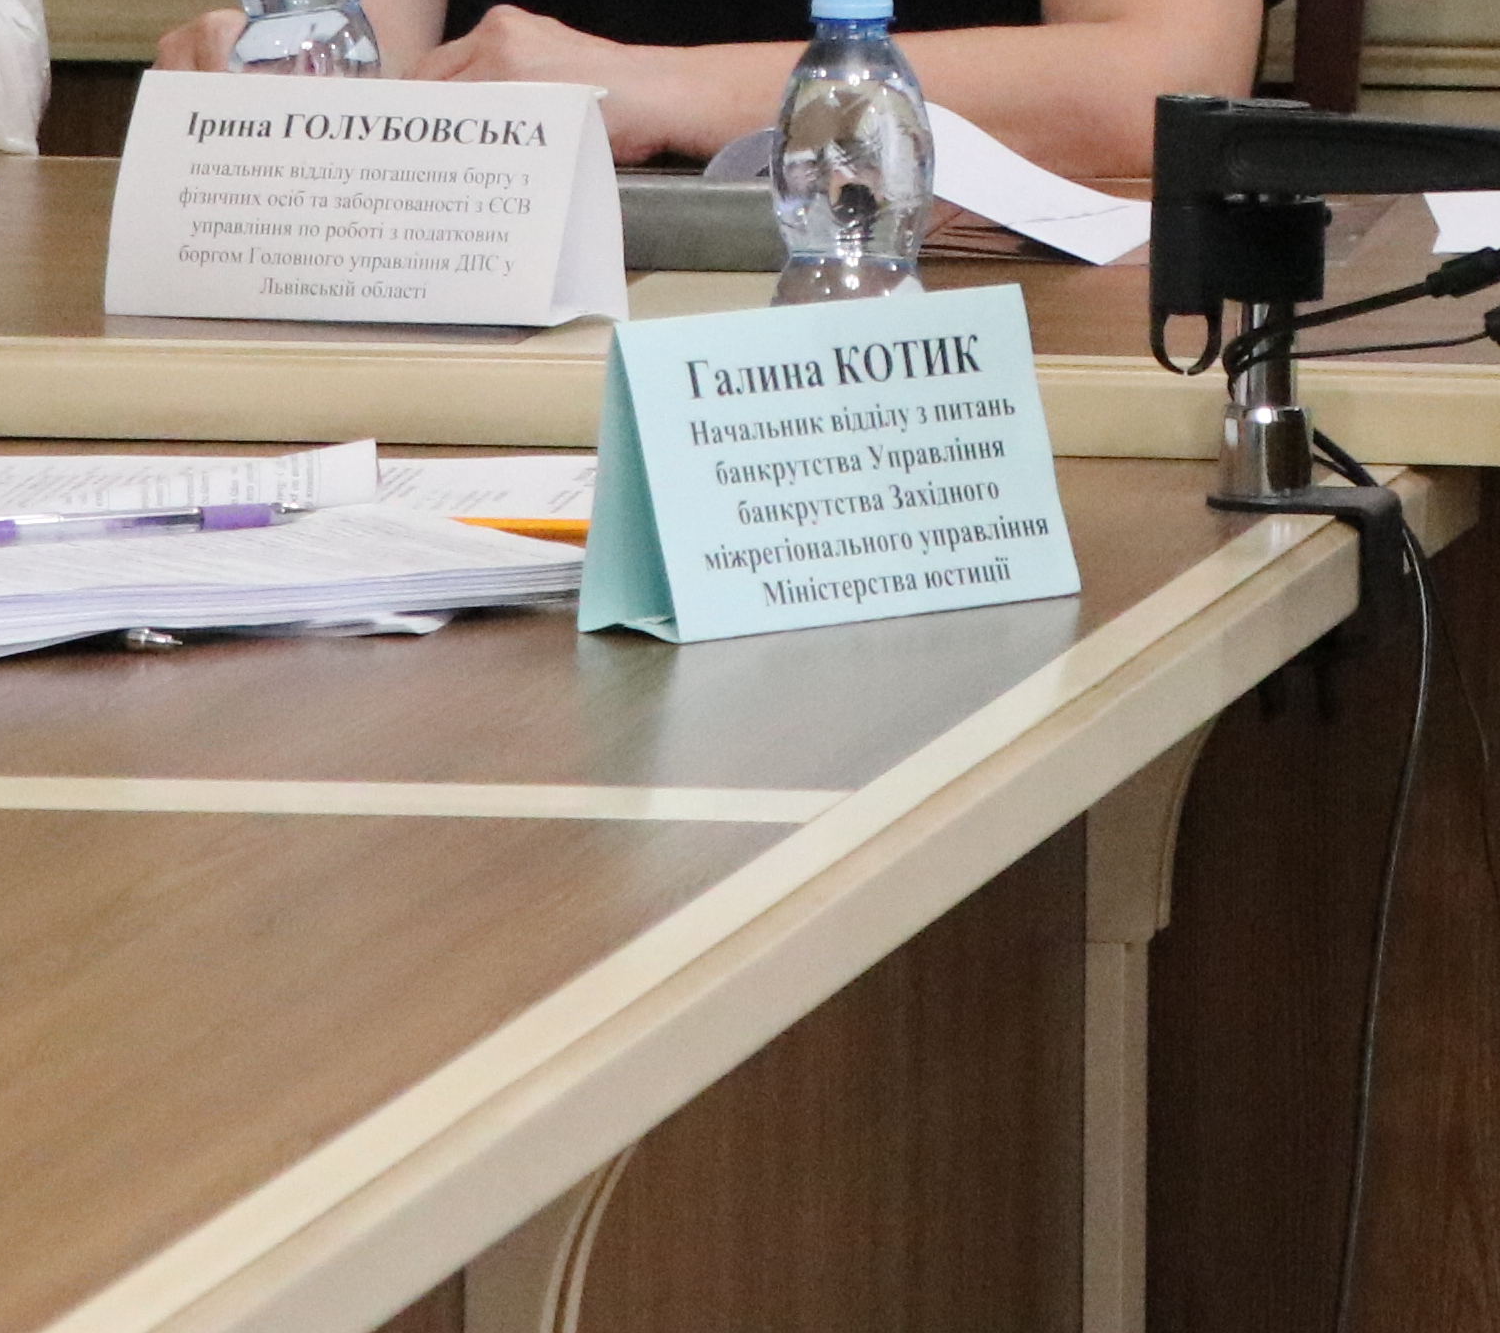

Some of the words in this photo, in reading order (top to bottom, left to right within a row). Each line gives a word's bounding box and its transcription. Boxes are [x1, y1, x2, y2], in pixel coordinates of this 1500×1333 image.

[188, 111, 272, 144] Ірина
[283, 113, 546, 146] ГОЛУБОВСЬКА
[189, 162, 285, 178] начальник
[289, 165, 352, 185] відділу
[359, 168, 458, 183] погашення
[462, 166, 513, 191] боргу
[178, 186, 261, 209] фізичних
[266, 189, 306, 208] осіб
[311, 195, 329, 209] та
[335, 191, 469, 215] заборгованості
[488, 196, 531, 215] ЄСВ
[190, 220, 293, 239] управління
[298, 224, 321, 237] по
[324, 221, 384, 243] роботі
[403, 228, 509, 243] податковим
[178, 244, 243, 268] боргом
[248, 246, 345, 267] Головного
[348, 255, 450, 274] управління
[454, 253, 500, 273] ДПС
[258, 276, 356, 297] Львівській
[360, 280, 427, 300] області
[686, 360, 825, 399] Галина
[833, 334, 980, 385] КОТИК
[690, 416, 824, 446] Начальник
[830, 403, 908, 433] відділу
[933, 398, 1016, 422] питань
[715, 454, 863, 488] банкрутства
[867, 437, 1005, 474] Управління
[738, 493, 885, 527] банкрутства
[891, 480, 1000, 510] Західного
[704, 532, 914, 574] міжрегіонального
[918, 515, 1049, 555] управління
[762, 573, 918, 605] Міністерства
[924, 556, 1011, 589] юстиції
